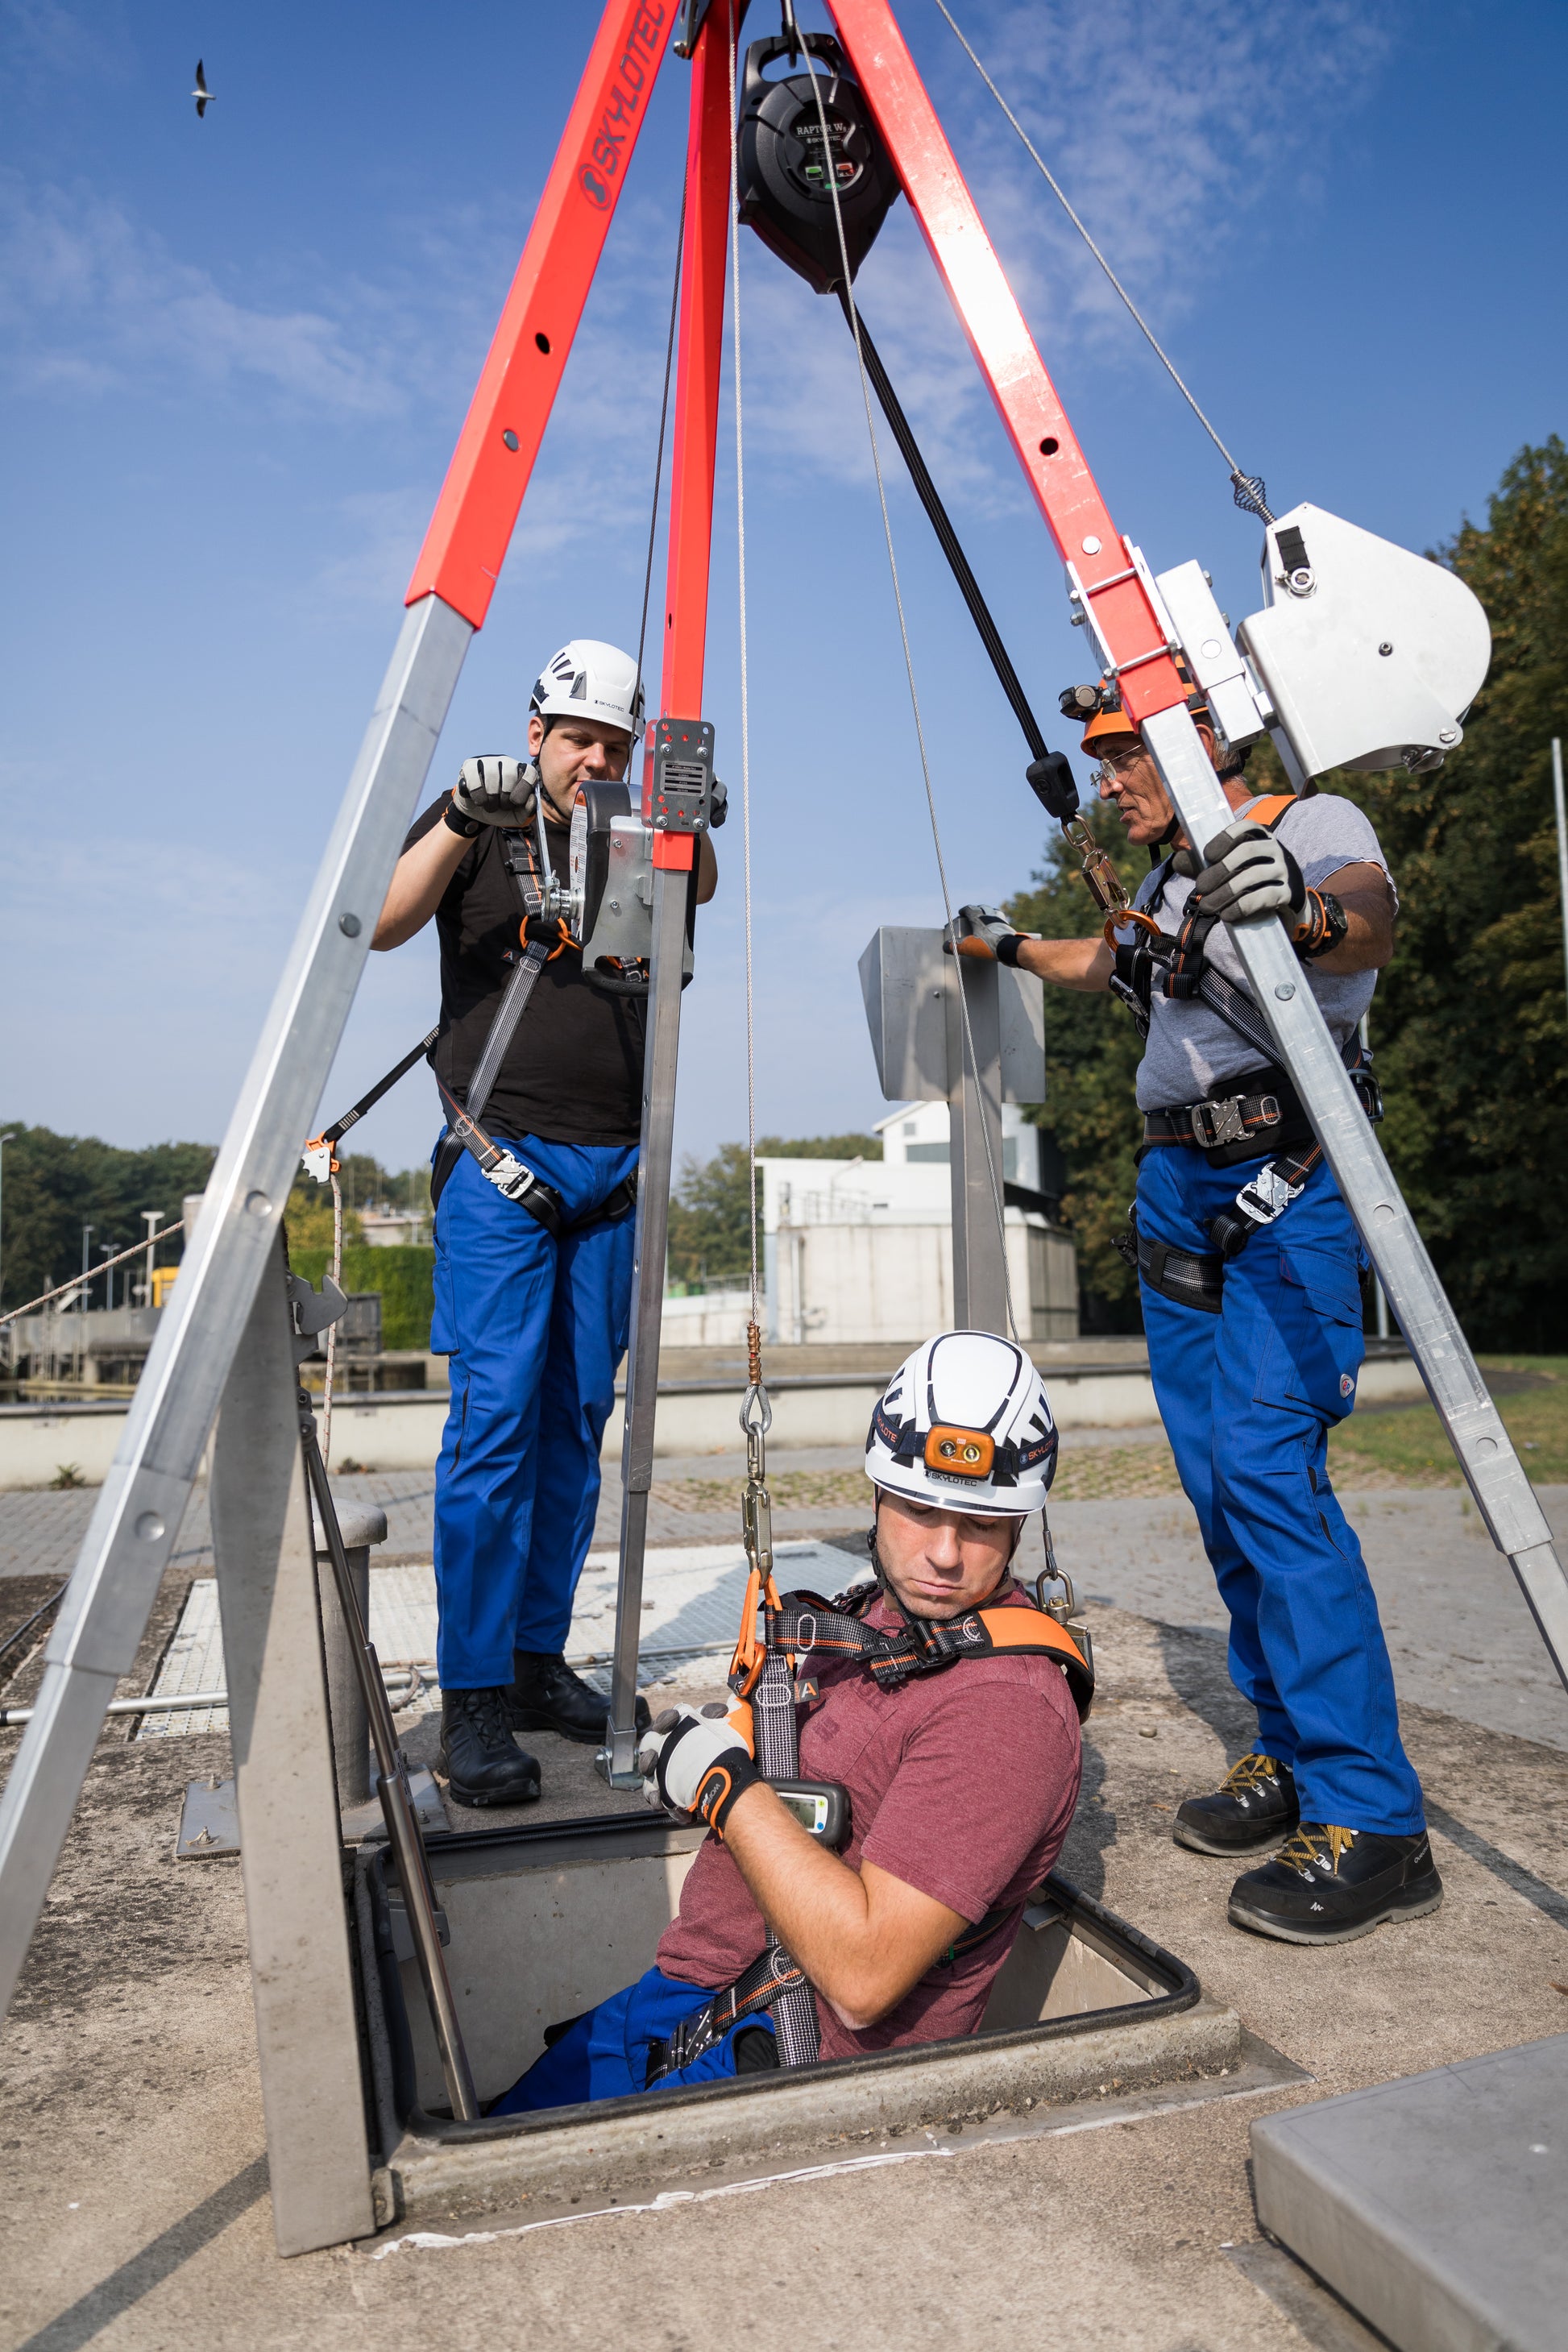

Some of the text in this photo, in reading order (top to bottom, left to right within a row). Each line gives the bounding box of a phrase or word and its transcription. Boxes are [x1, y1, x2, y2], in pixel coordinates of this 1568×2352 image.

[592, 0, 666, 176] SKYLOTEC
[811, 135, 841, 143] SKYTEC
[599, 700, 625, 712] SKYLOTEC
[931, 1472, 977, 1487] SKYLOTEC
